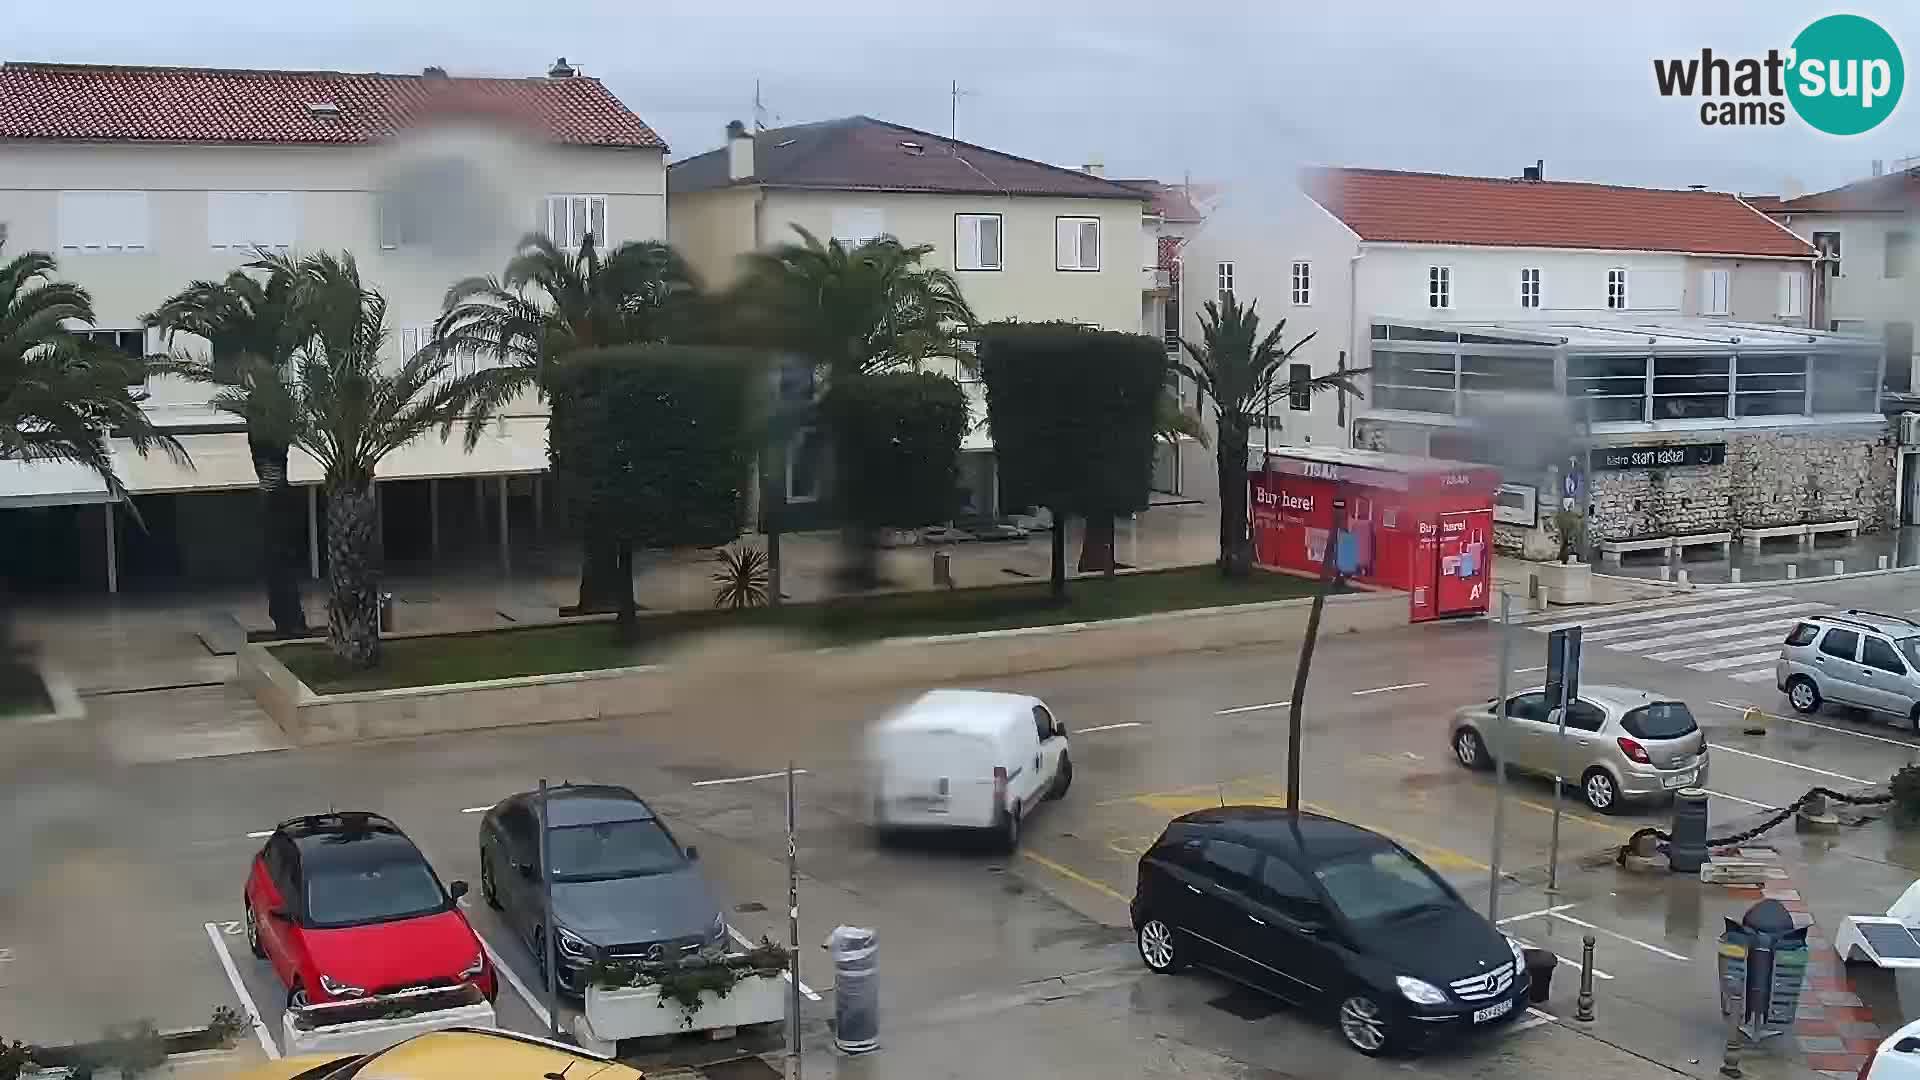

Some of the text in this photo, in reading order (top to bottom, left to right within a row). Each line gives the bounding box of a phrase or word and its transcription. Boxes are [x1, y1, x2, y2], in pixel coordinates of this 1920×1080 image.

[1256, 486, 1314, 512] Buy here!
[1419, 521, 1438, 536] Buy
[1469, 581, 1483, 601] A1
